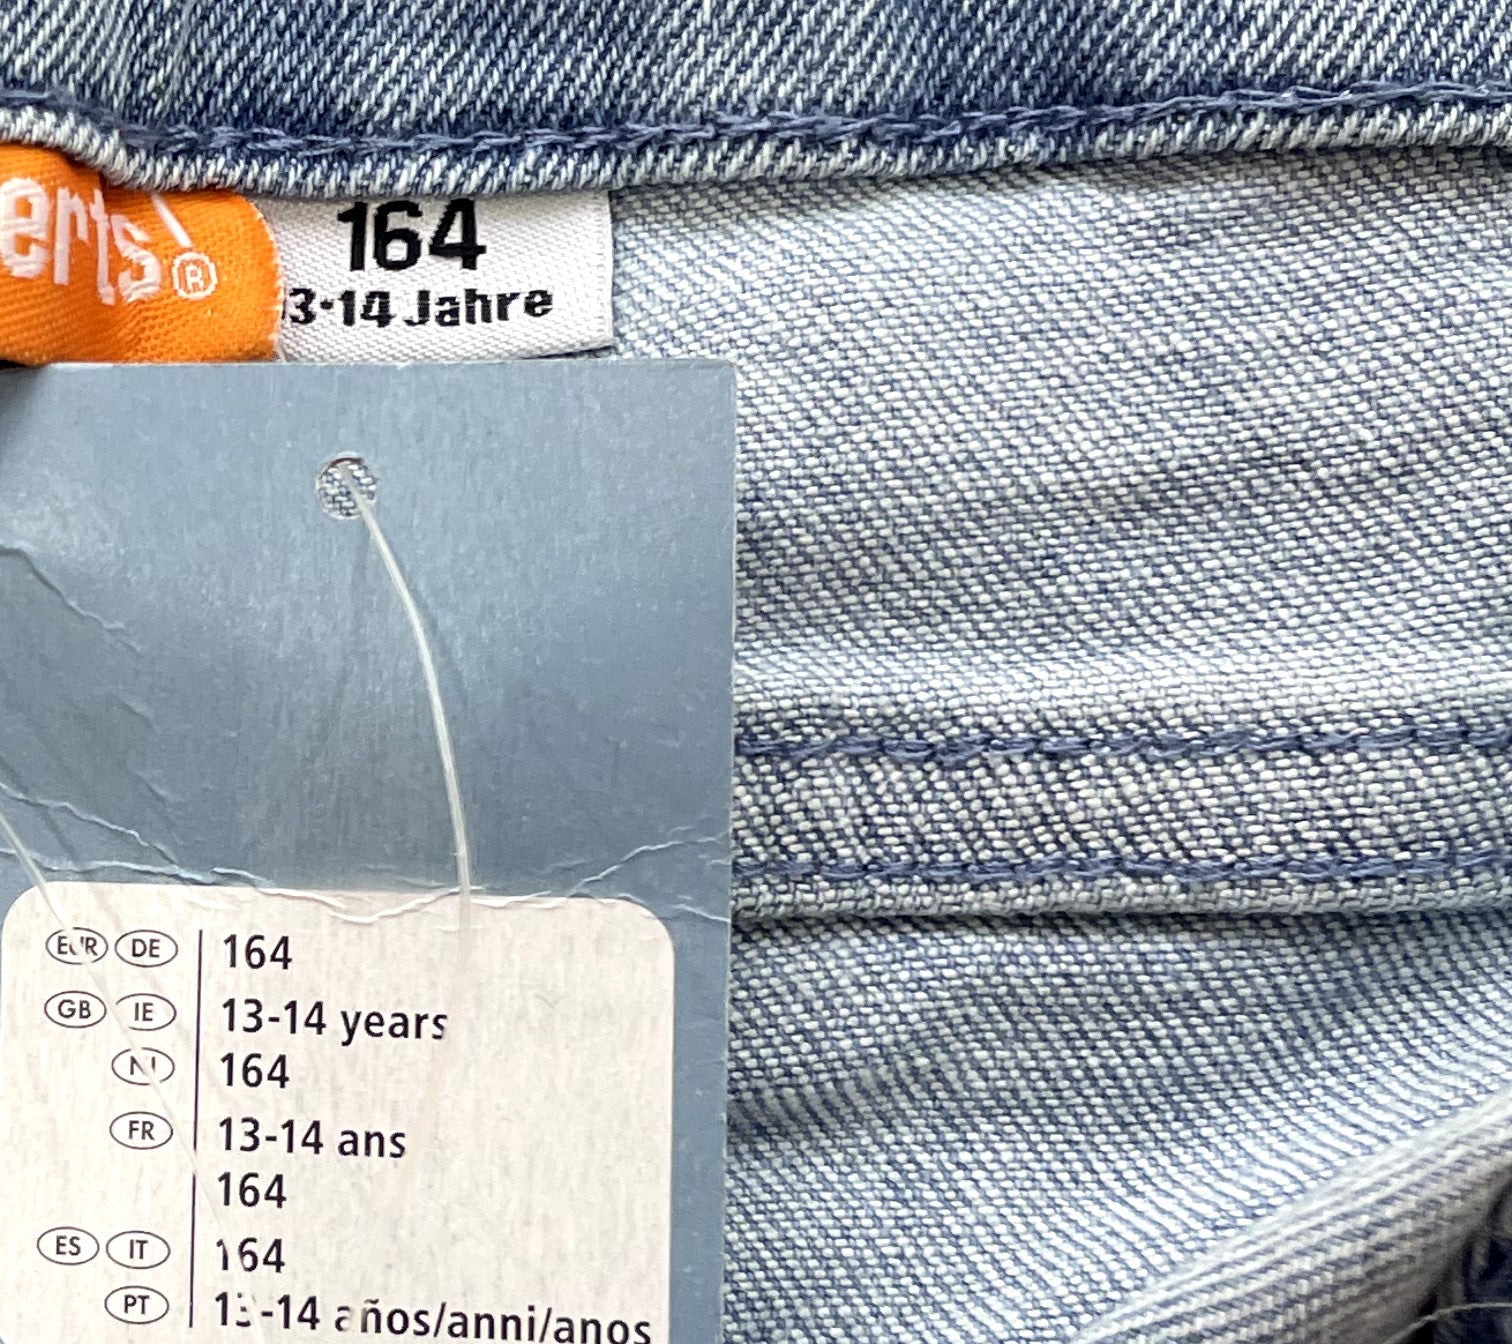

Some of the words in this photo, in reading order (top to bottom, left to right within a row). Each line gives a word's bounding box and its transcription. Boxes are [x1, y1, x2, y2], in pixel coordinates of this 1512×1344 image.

[337, 197, 487, 272] 164
[282, 287, 396, 328] 3-14
[403, 288, 554, 327] Jahre
[131, 938, 161, 959] DE
[222, 933, 294, 971] 164
[57, 999, 92, 1020] GB
[134, 1002, 154, 1022] IE
[220, 997, 328, 1036] 13-14
[339, 1009, 449, 1048] years
[219, 1051, 291, 1090] 164
[128, 1119, 156, 1141] FR
[218, 1115, 325, 1156] 13-14
[337, 1129, 407, 1160] ans
[217, 1170, 288, 1210] 164
[54, 1234, 82, 1257] ES
[128, 1238, 150, 1261] IT
[215, 1236, 287, 1274] 164
[124, 1293, 151, 1316] PT
